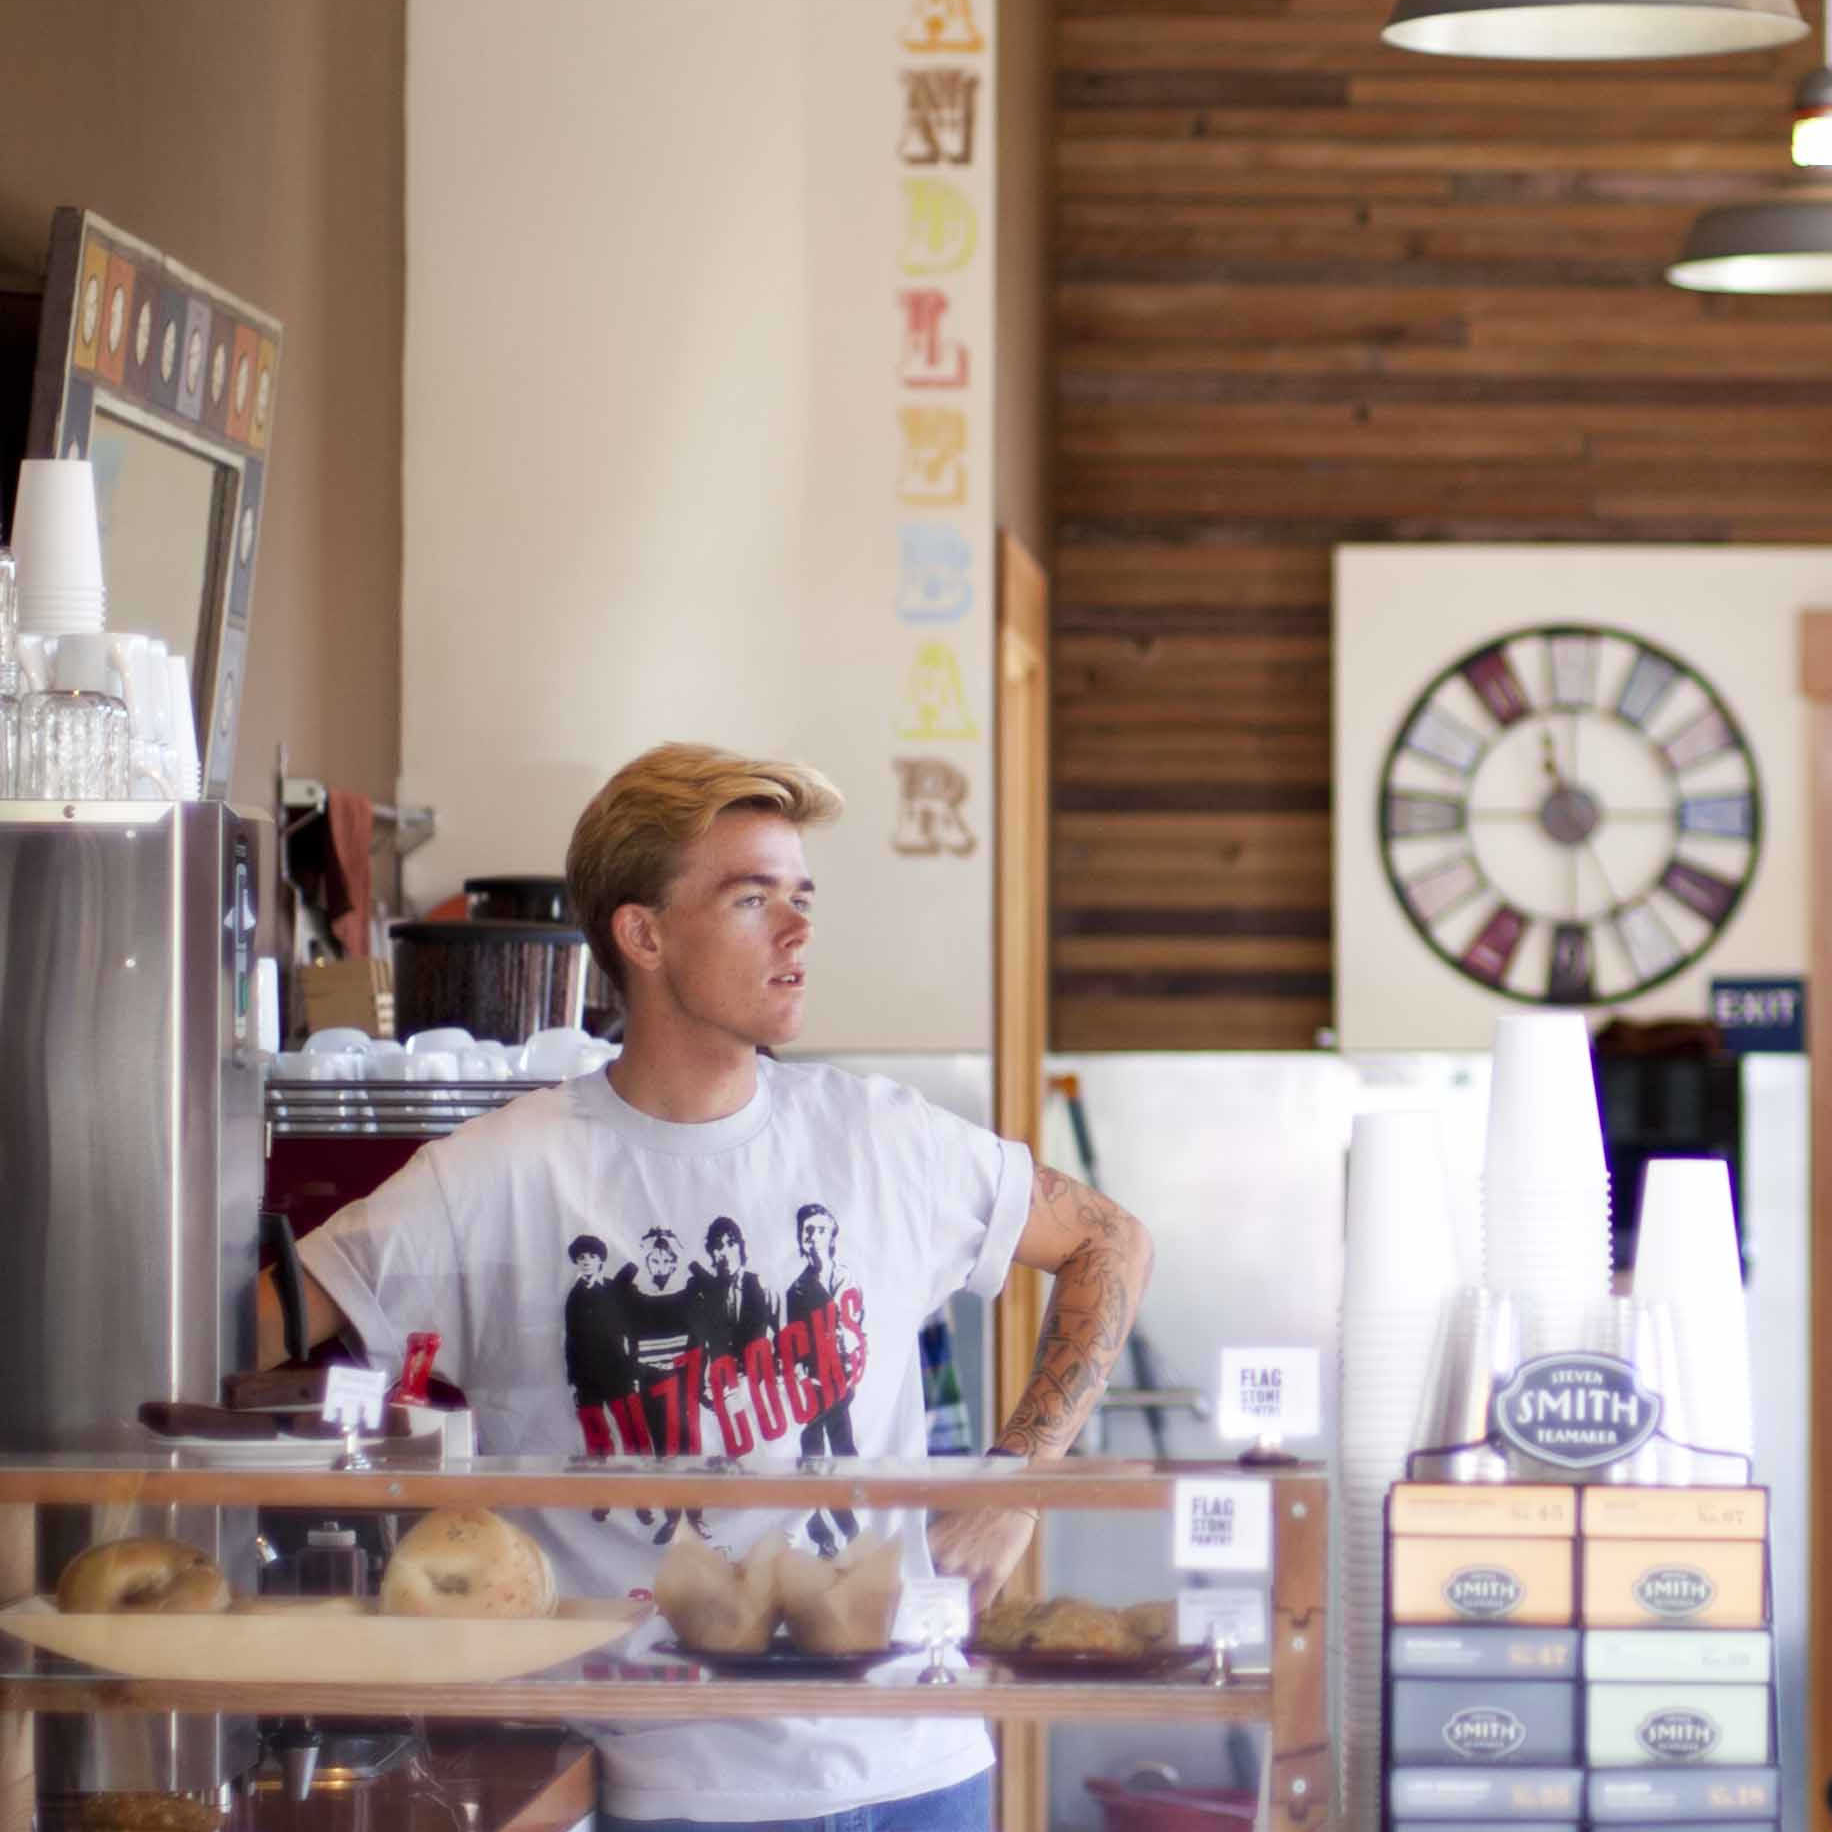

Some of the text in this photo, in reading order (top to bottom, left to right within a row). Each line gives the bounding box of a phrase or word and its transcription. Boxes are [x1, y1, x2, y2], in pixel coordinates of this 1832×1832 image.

[1716, 989, 1798, 1027] EXIT
[1240, 1368, 1282, 1388] FLAG
[1551, 1370, 1604, 1386] STEVEN
[1516, 1387, 1639, 1428] SMITH
[1537, 1428, 1619, 1445] TEAMAKER
[1192, 1497, 1235, 1517] FLAG
[1454, 1580, 1516, 1599] SMITH
[1645, 1580, 1707, 1599] SMITH
[1453, 1720, 1516, 1741] SMITH
[1649, 1723, 1710, 1743] SMITH
